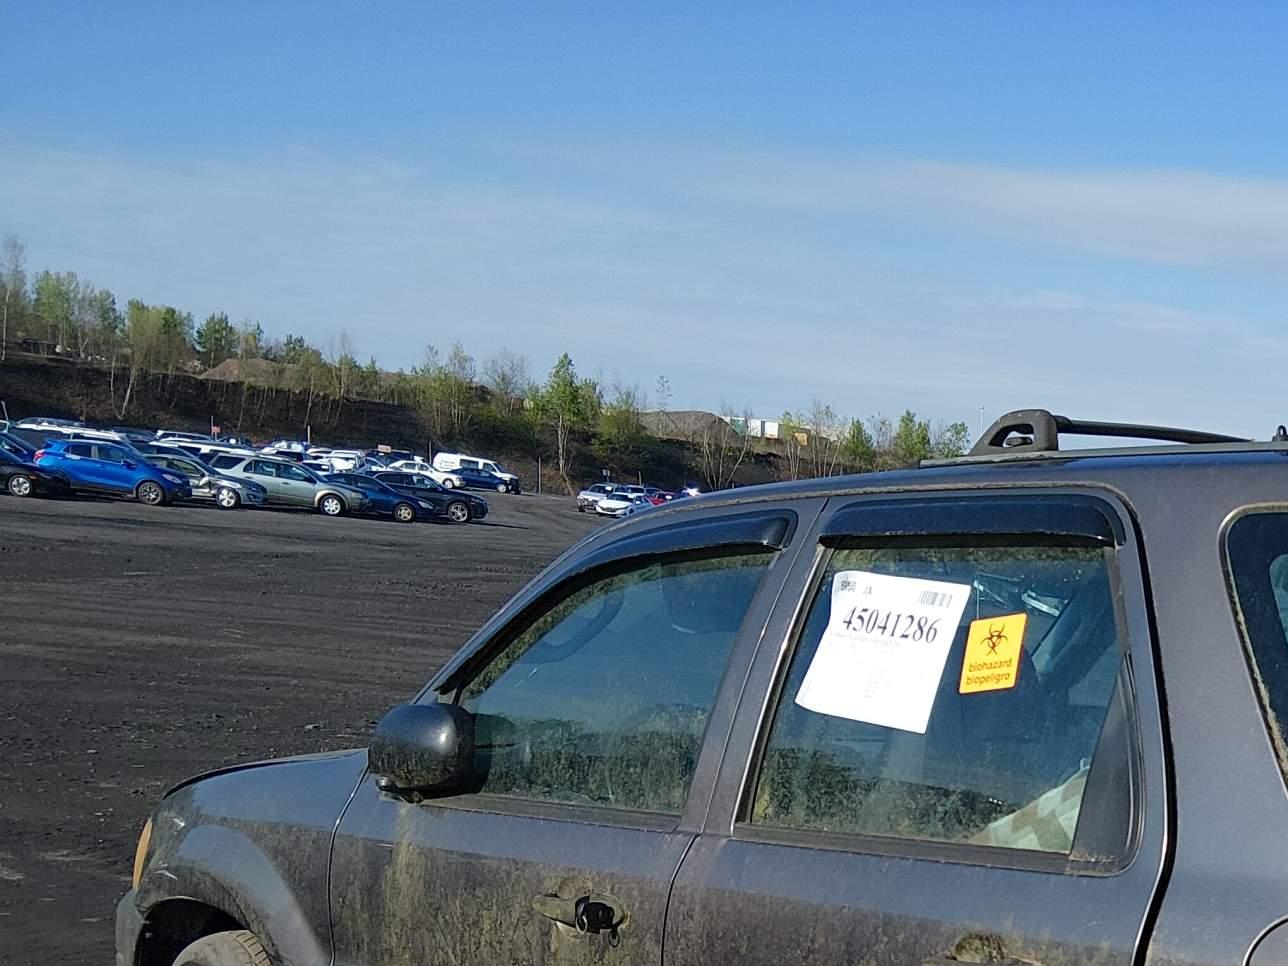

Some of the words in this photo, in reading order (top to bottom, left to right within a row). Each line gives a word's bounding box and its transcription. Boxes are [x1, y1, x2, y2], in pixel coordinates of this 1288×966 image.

[842, 606, 942, 644] 45041286
[968, 658, 1012, 673] biohazard
[965, 673, 1010, 686] biopeligro
